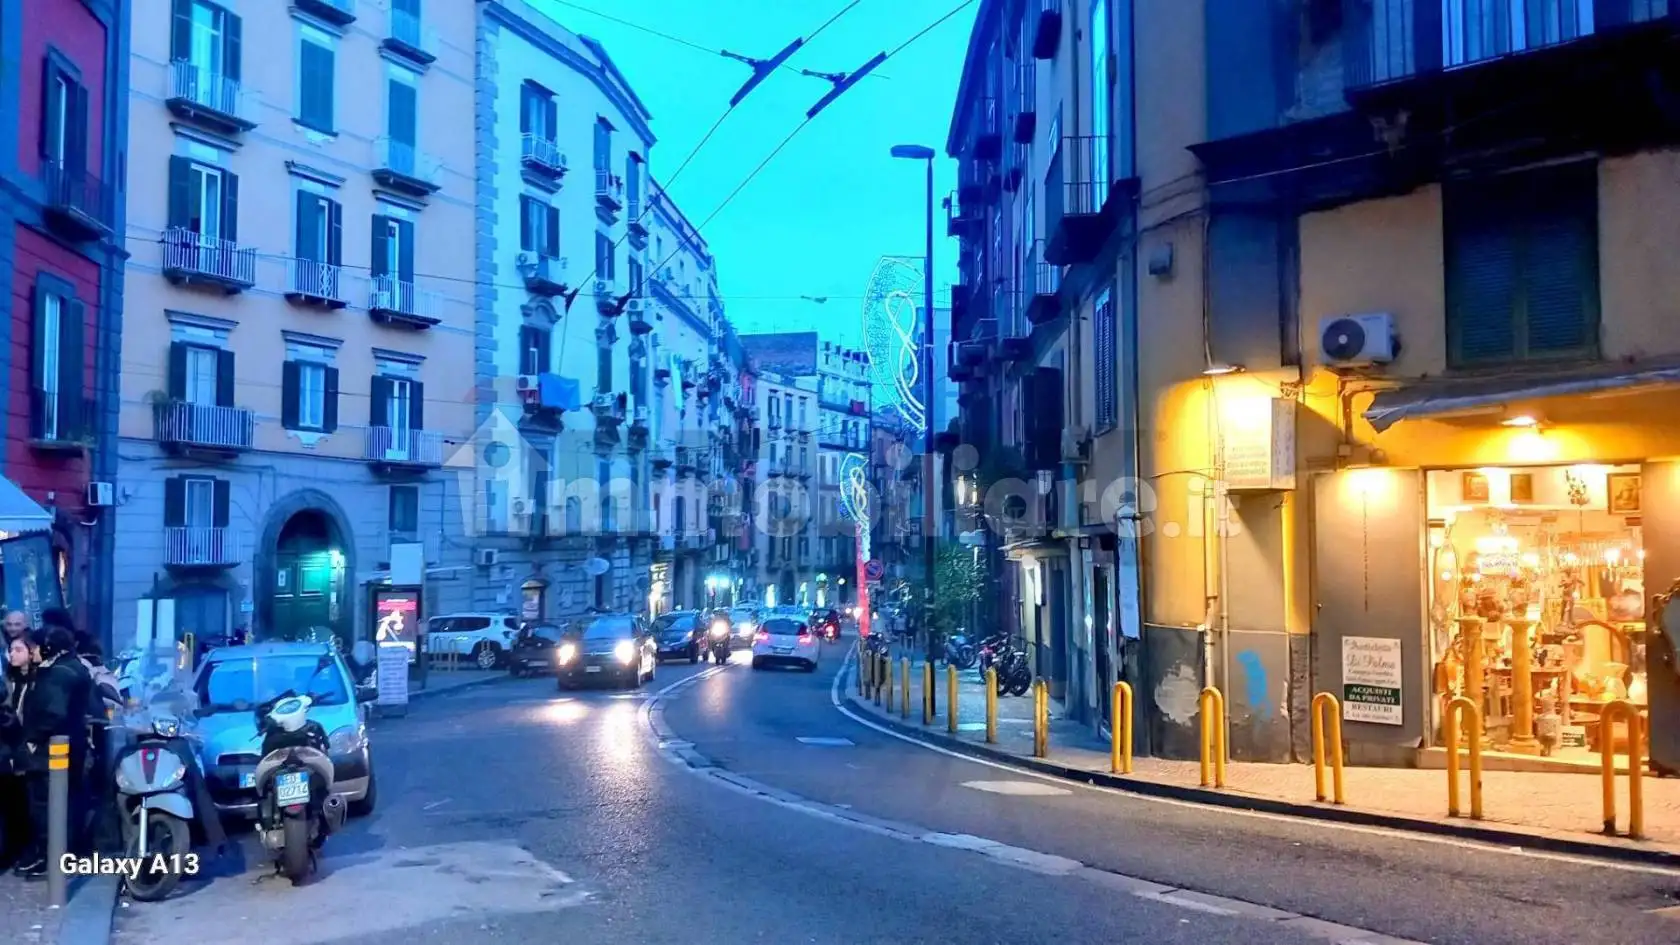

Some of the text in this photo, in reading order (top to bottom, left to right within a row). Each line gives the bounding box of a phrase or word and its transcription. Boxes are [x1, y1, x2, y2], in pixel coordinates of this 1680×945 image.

[1351, 686, 1392, 696] ACQUISTI
[1362, 695, 1396, 704] PRIVATI
[1351, 703, 1393, 713] RESTAURI
